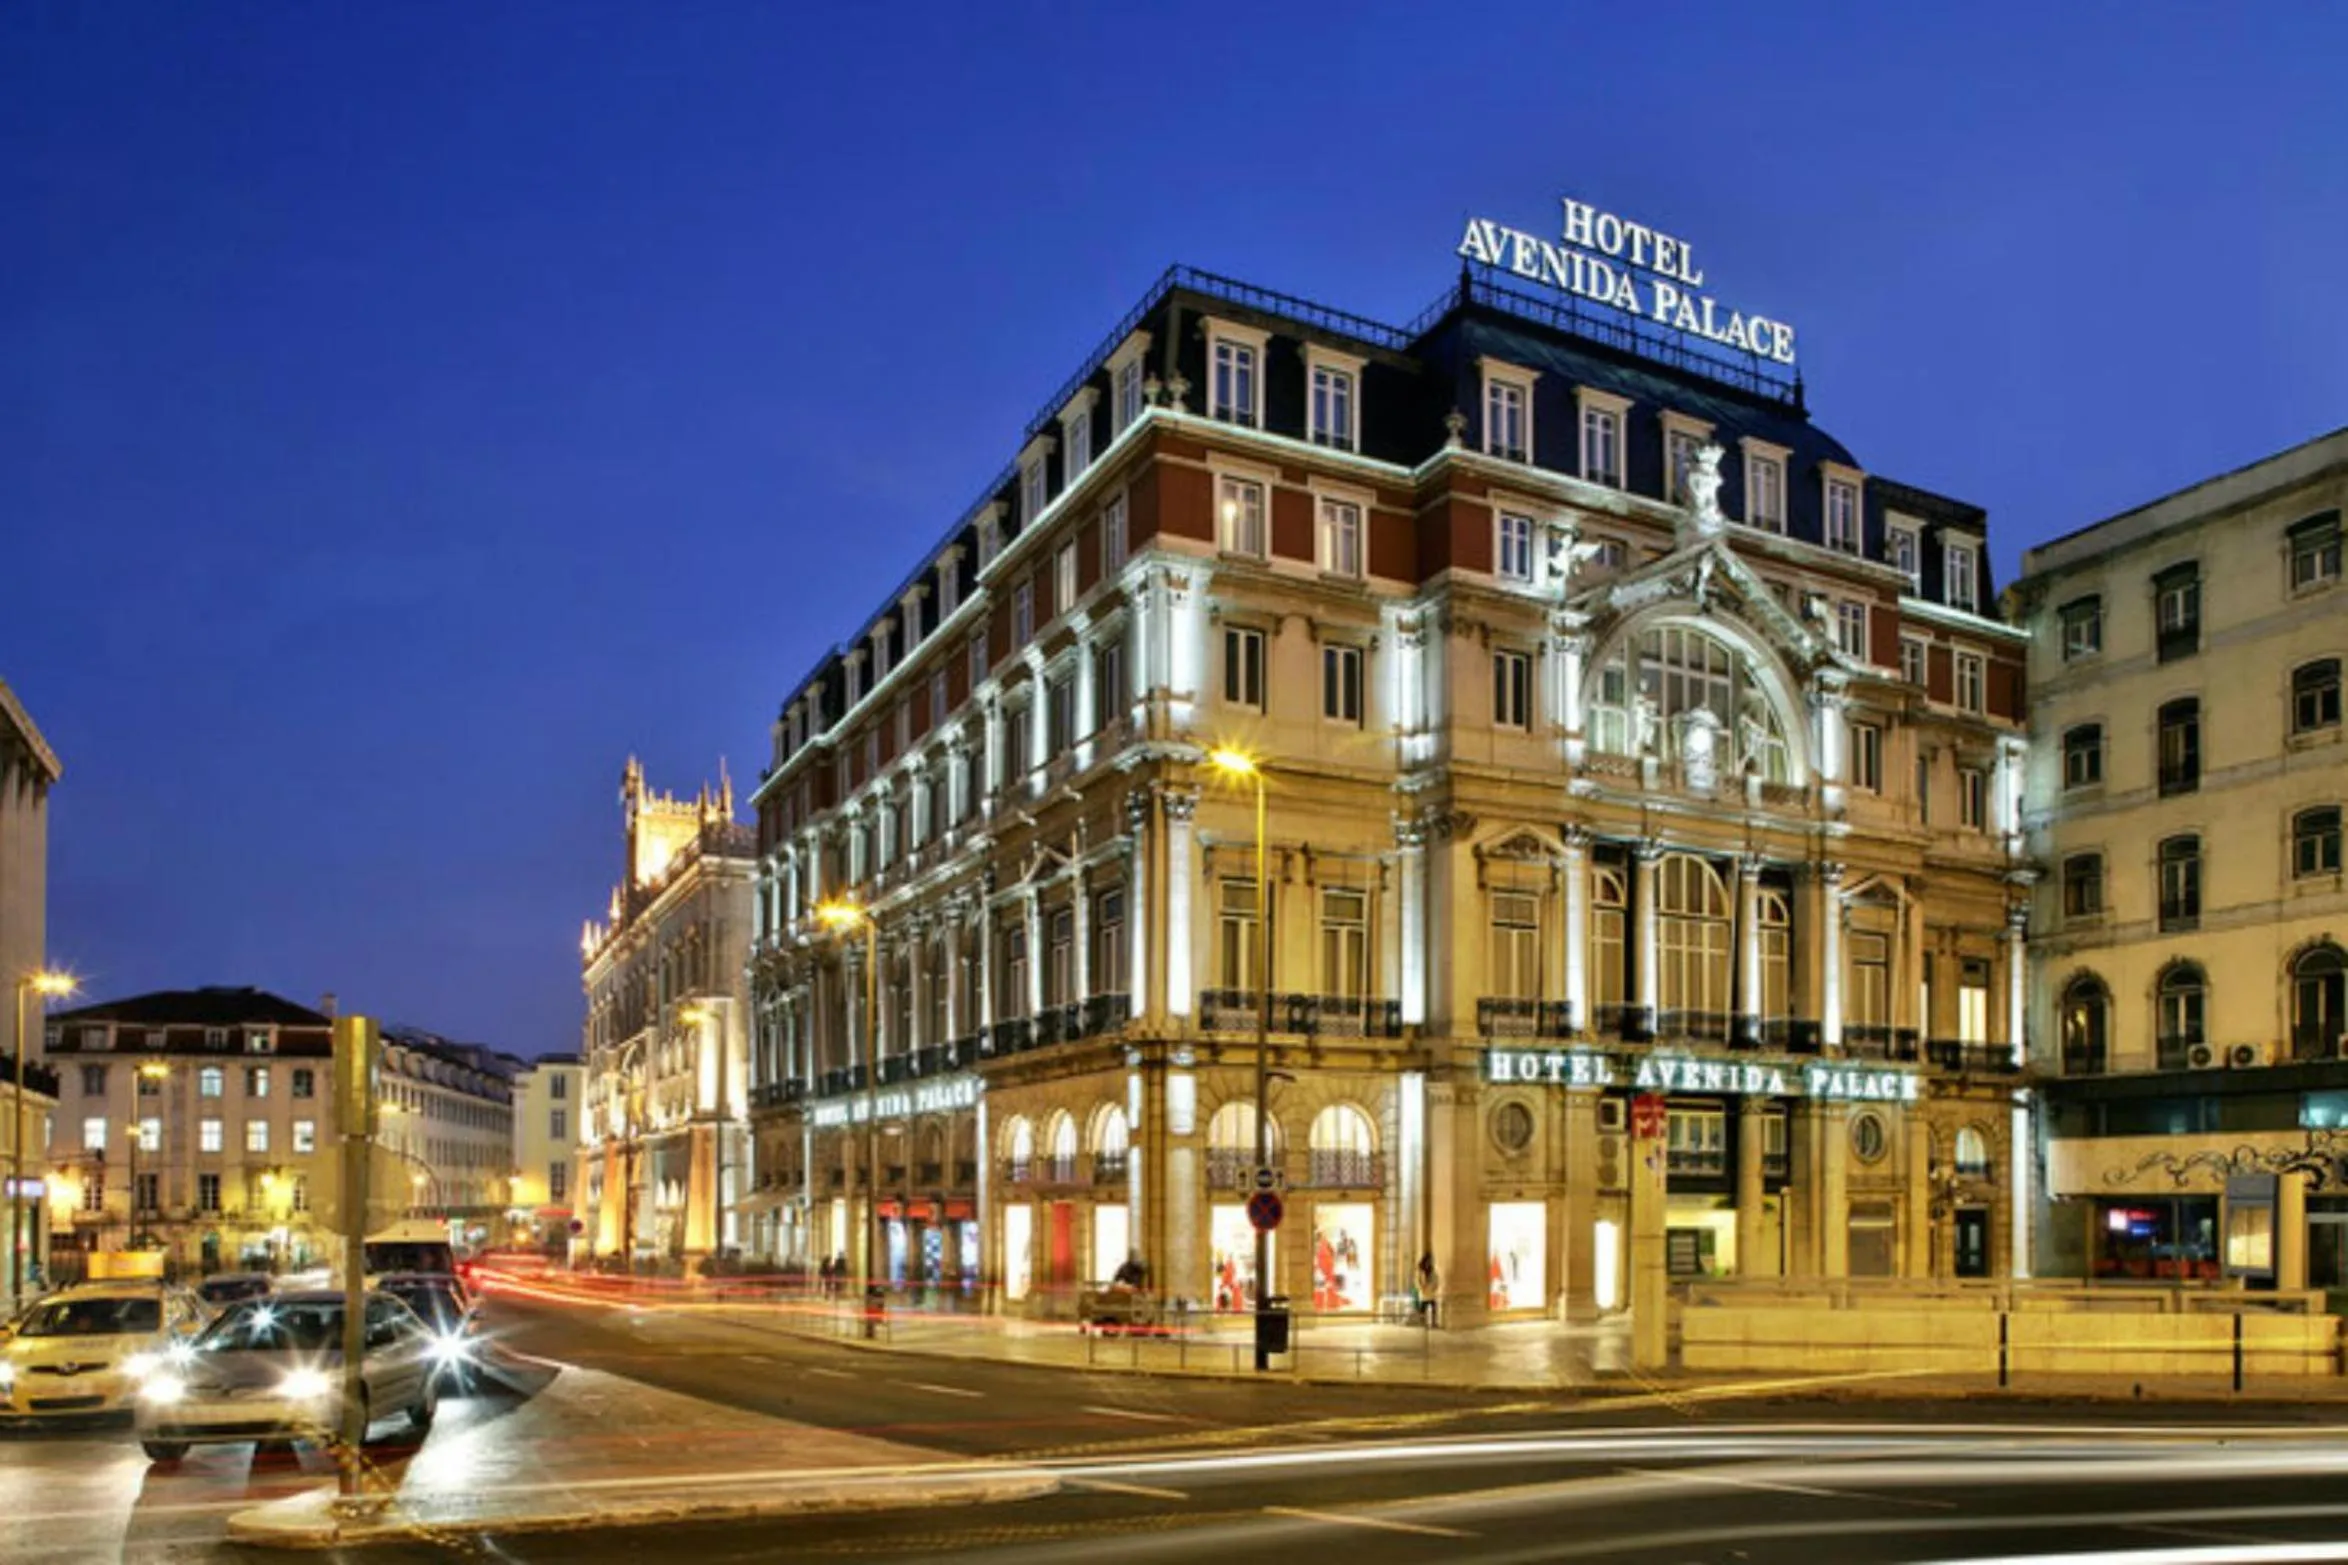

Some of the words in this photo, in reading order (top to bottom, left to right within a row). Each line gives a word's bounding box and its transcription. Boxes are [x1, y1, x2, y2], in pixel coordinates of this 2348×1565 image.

[1563, 198, 1703, 287] HOTEL
[1457, 217, 1642, 314] AVENIDA
[1652, 279, 1795, 365] PALACE
[1490, 1051, 1614, 1083] HOTEL
[1636, 1058, 1786, 1094] AVENIDA
[1811, 1069, 1918, 1099] PALACE
